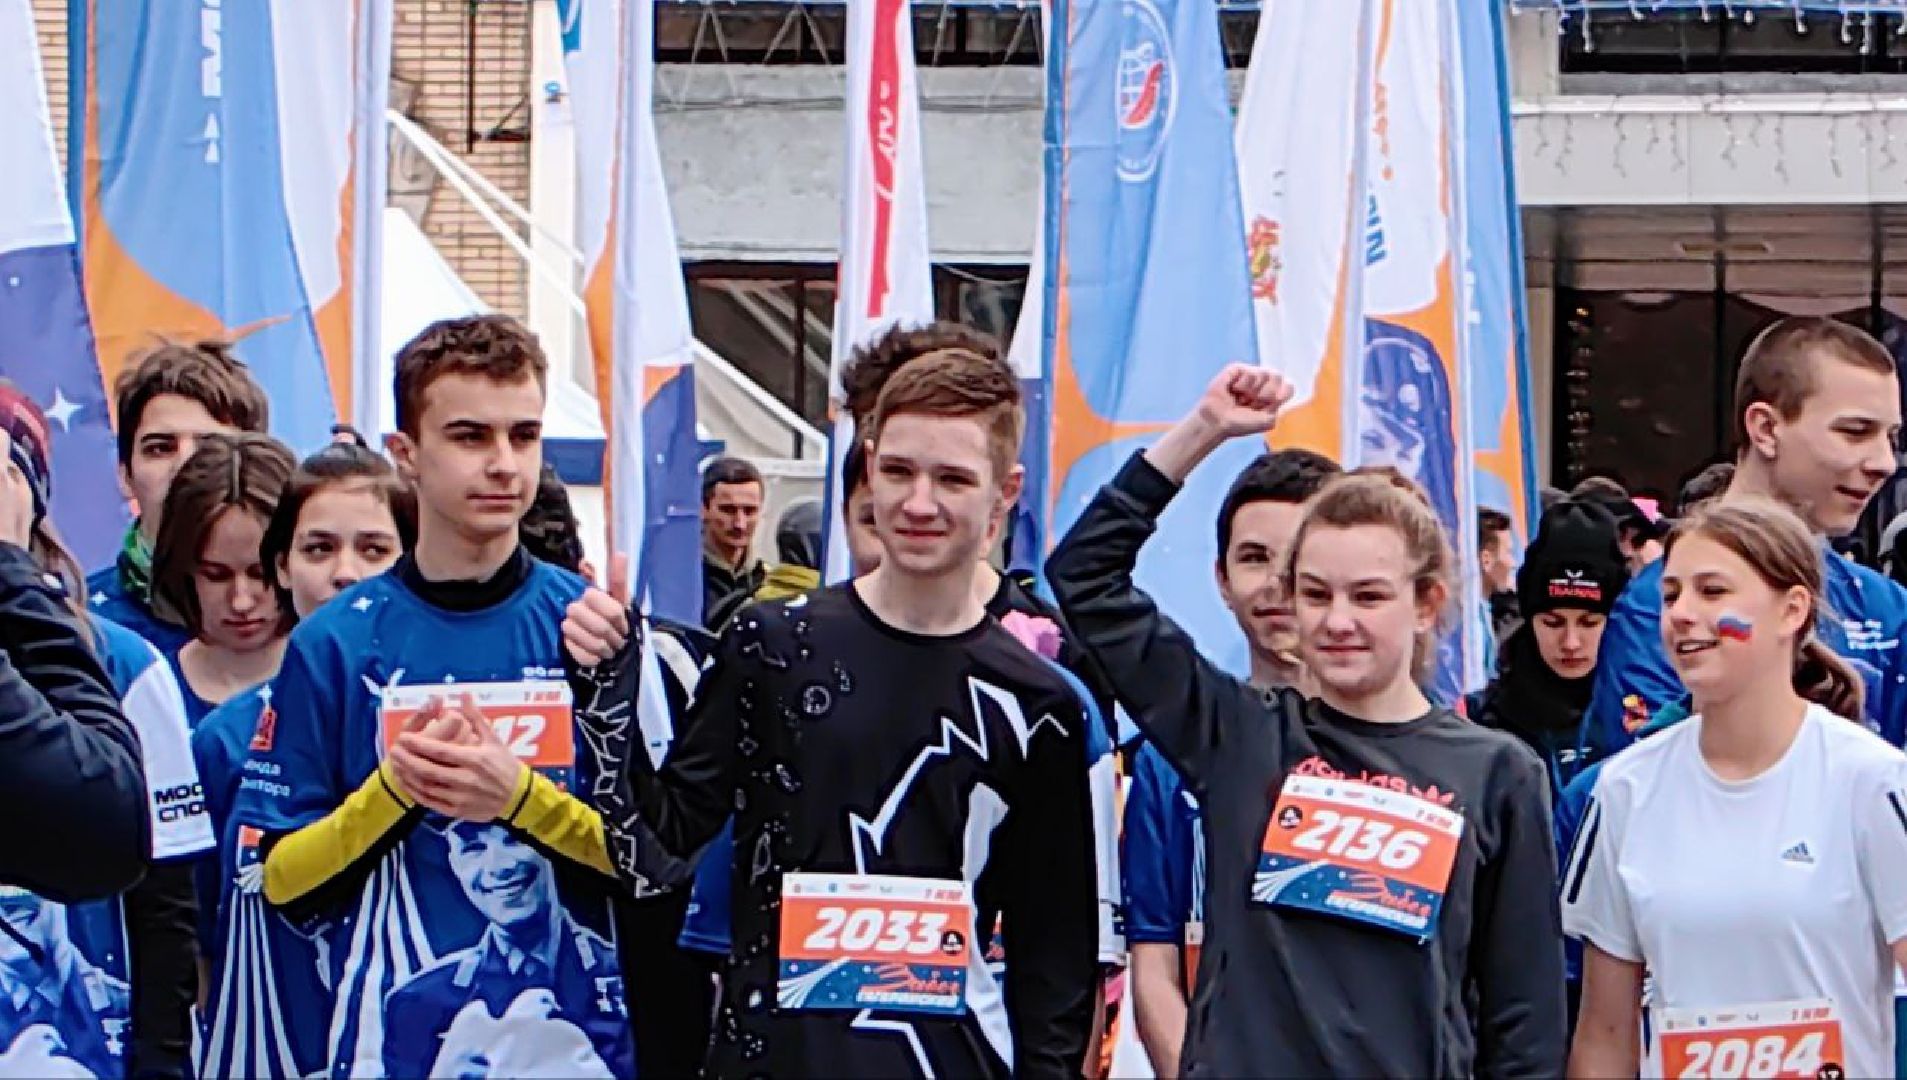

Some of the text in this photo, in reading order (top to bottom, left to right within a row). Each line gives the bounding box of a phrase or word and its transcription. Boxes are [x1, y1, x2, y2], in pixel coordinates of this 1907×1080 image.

[493, 714, 546, 758] 12
[1292, 809, 1431, 870] 2136
[803, 906, 948, 954] 2033
[1677, 1031, 1827, 1079] 2084
